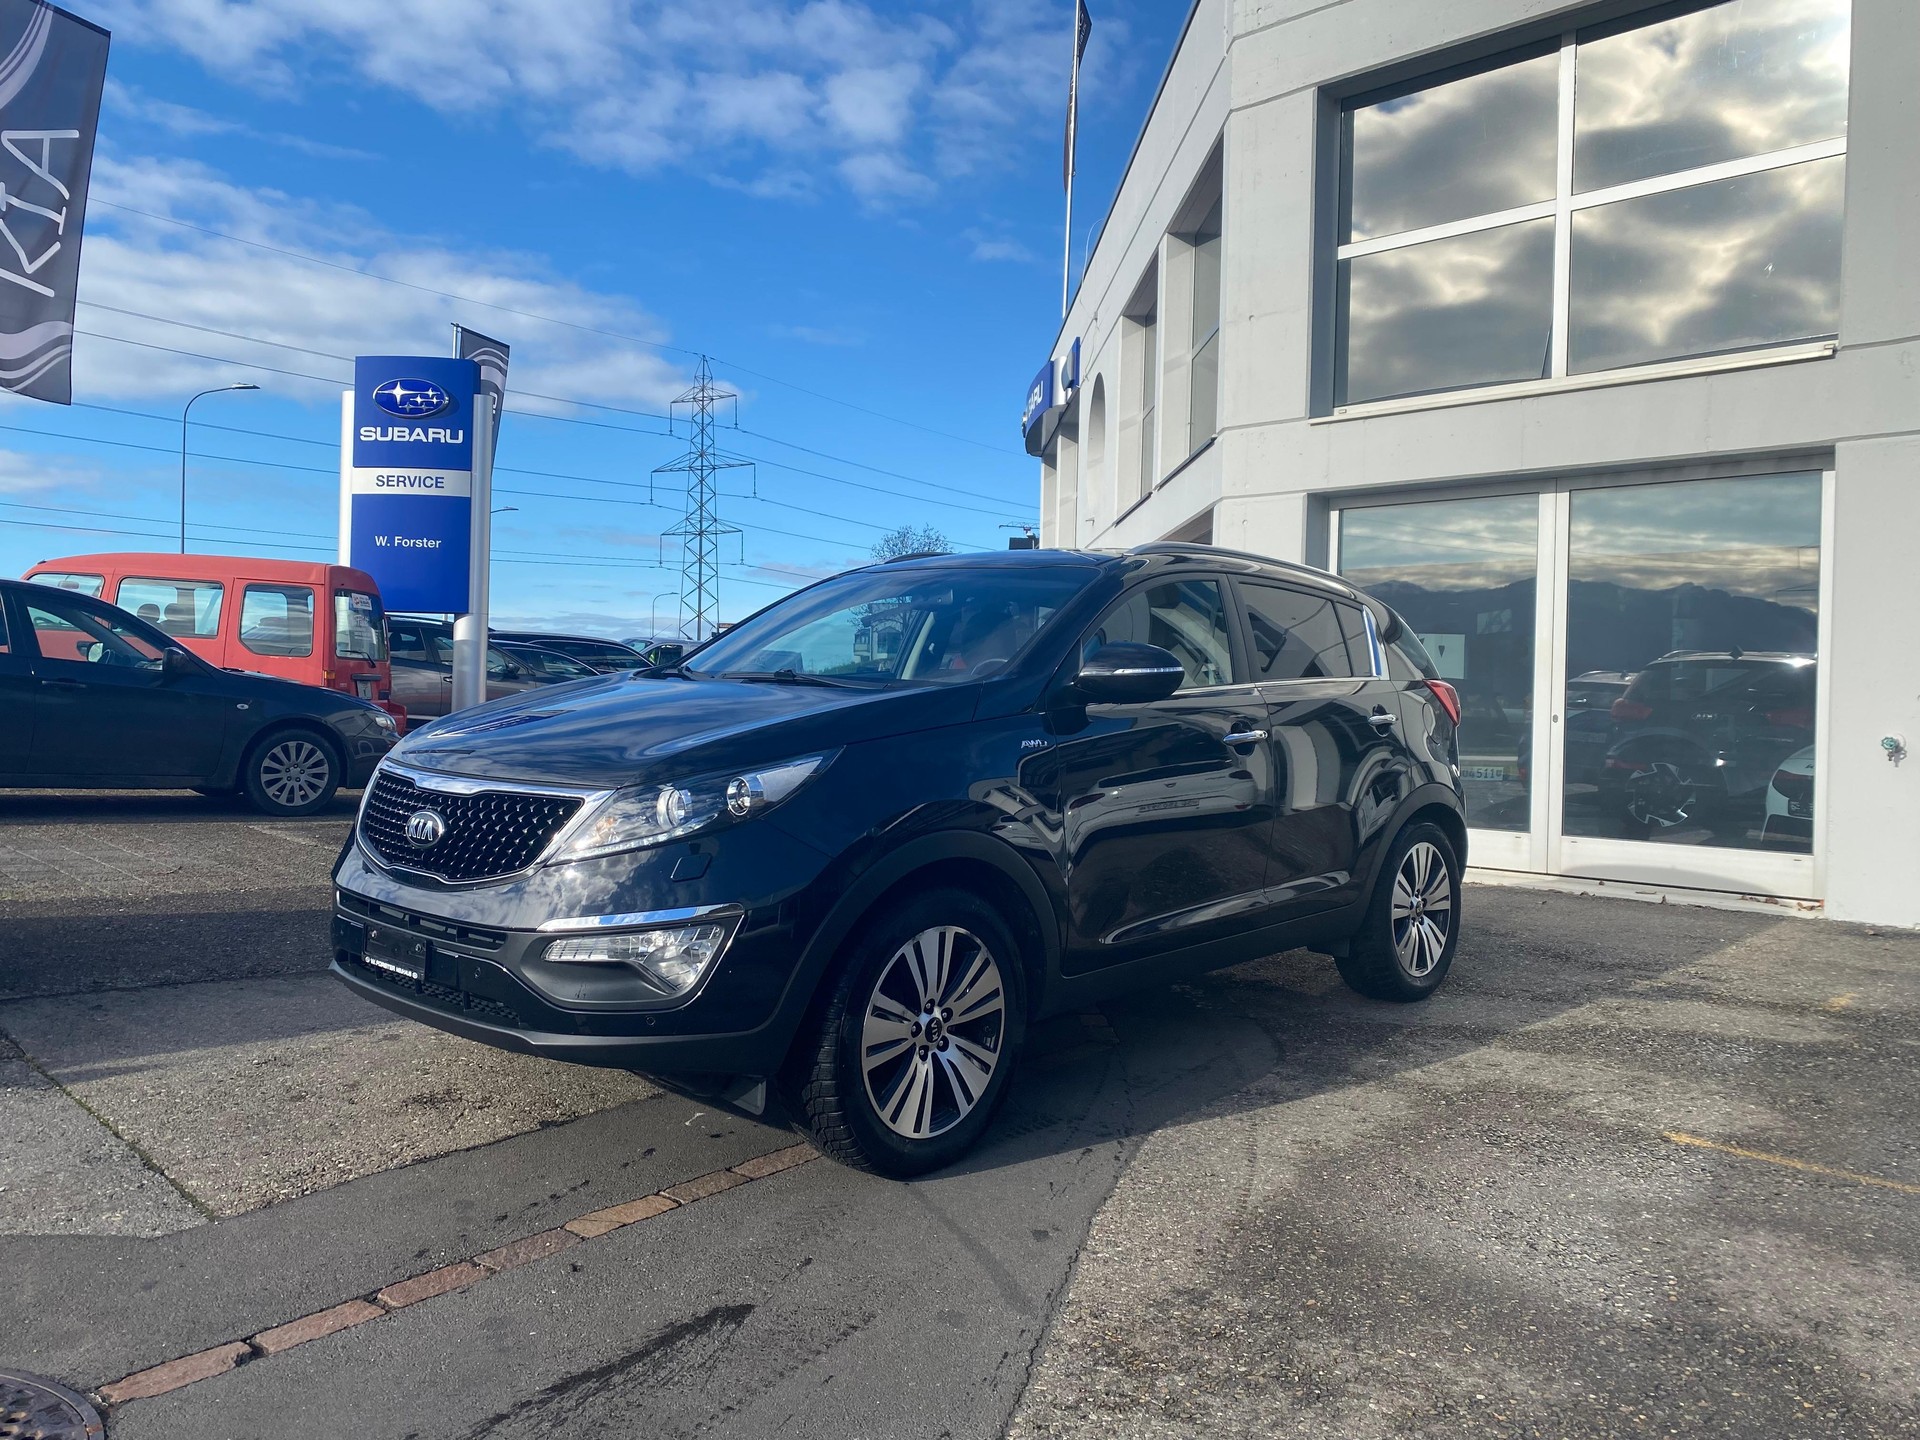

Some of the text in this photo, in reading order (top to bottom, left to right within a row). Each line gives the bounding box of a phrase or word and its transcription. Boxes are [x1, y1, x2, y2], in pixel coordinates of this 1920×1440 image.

[0, 129, 79, 297] KIA
[359, 426, 464, 444] SUBARU
[375, 474, 445, 489] SERVICE
[374, 535, 442, 548] W. Forster
[408, 817, 434, 841] KIA
